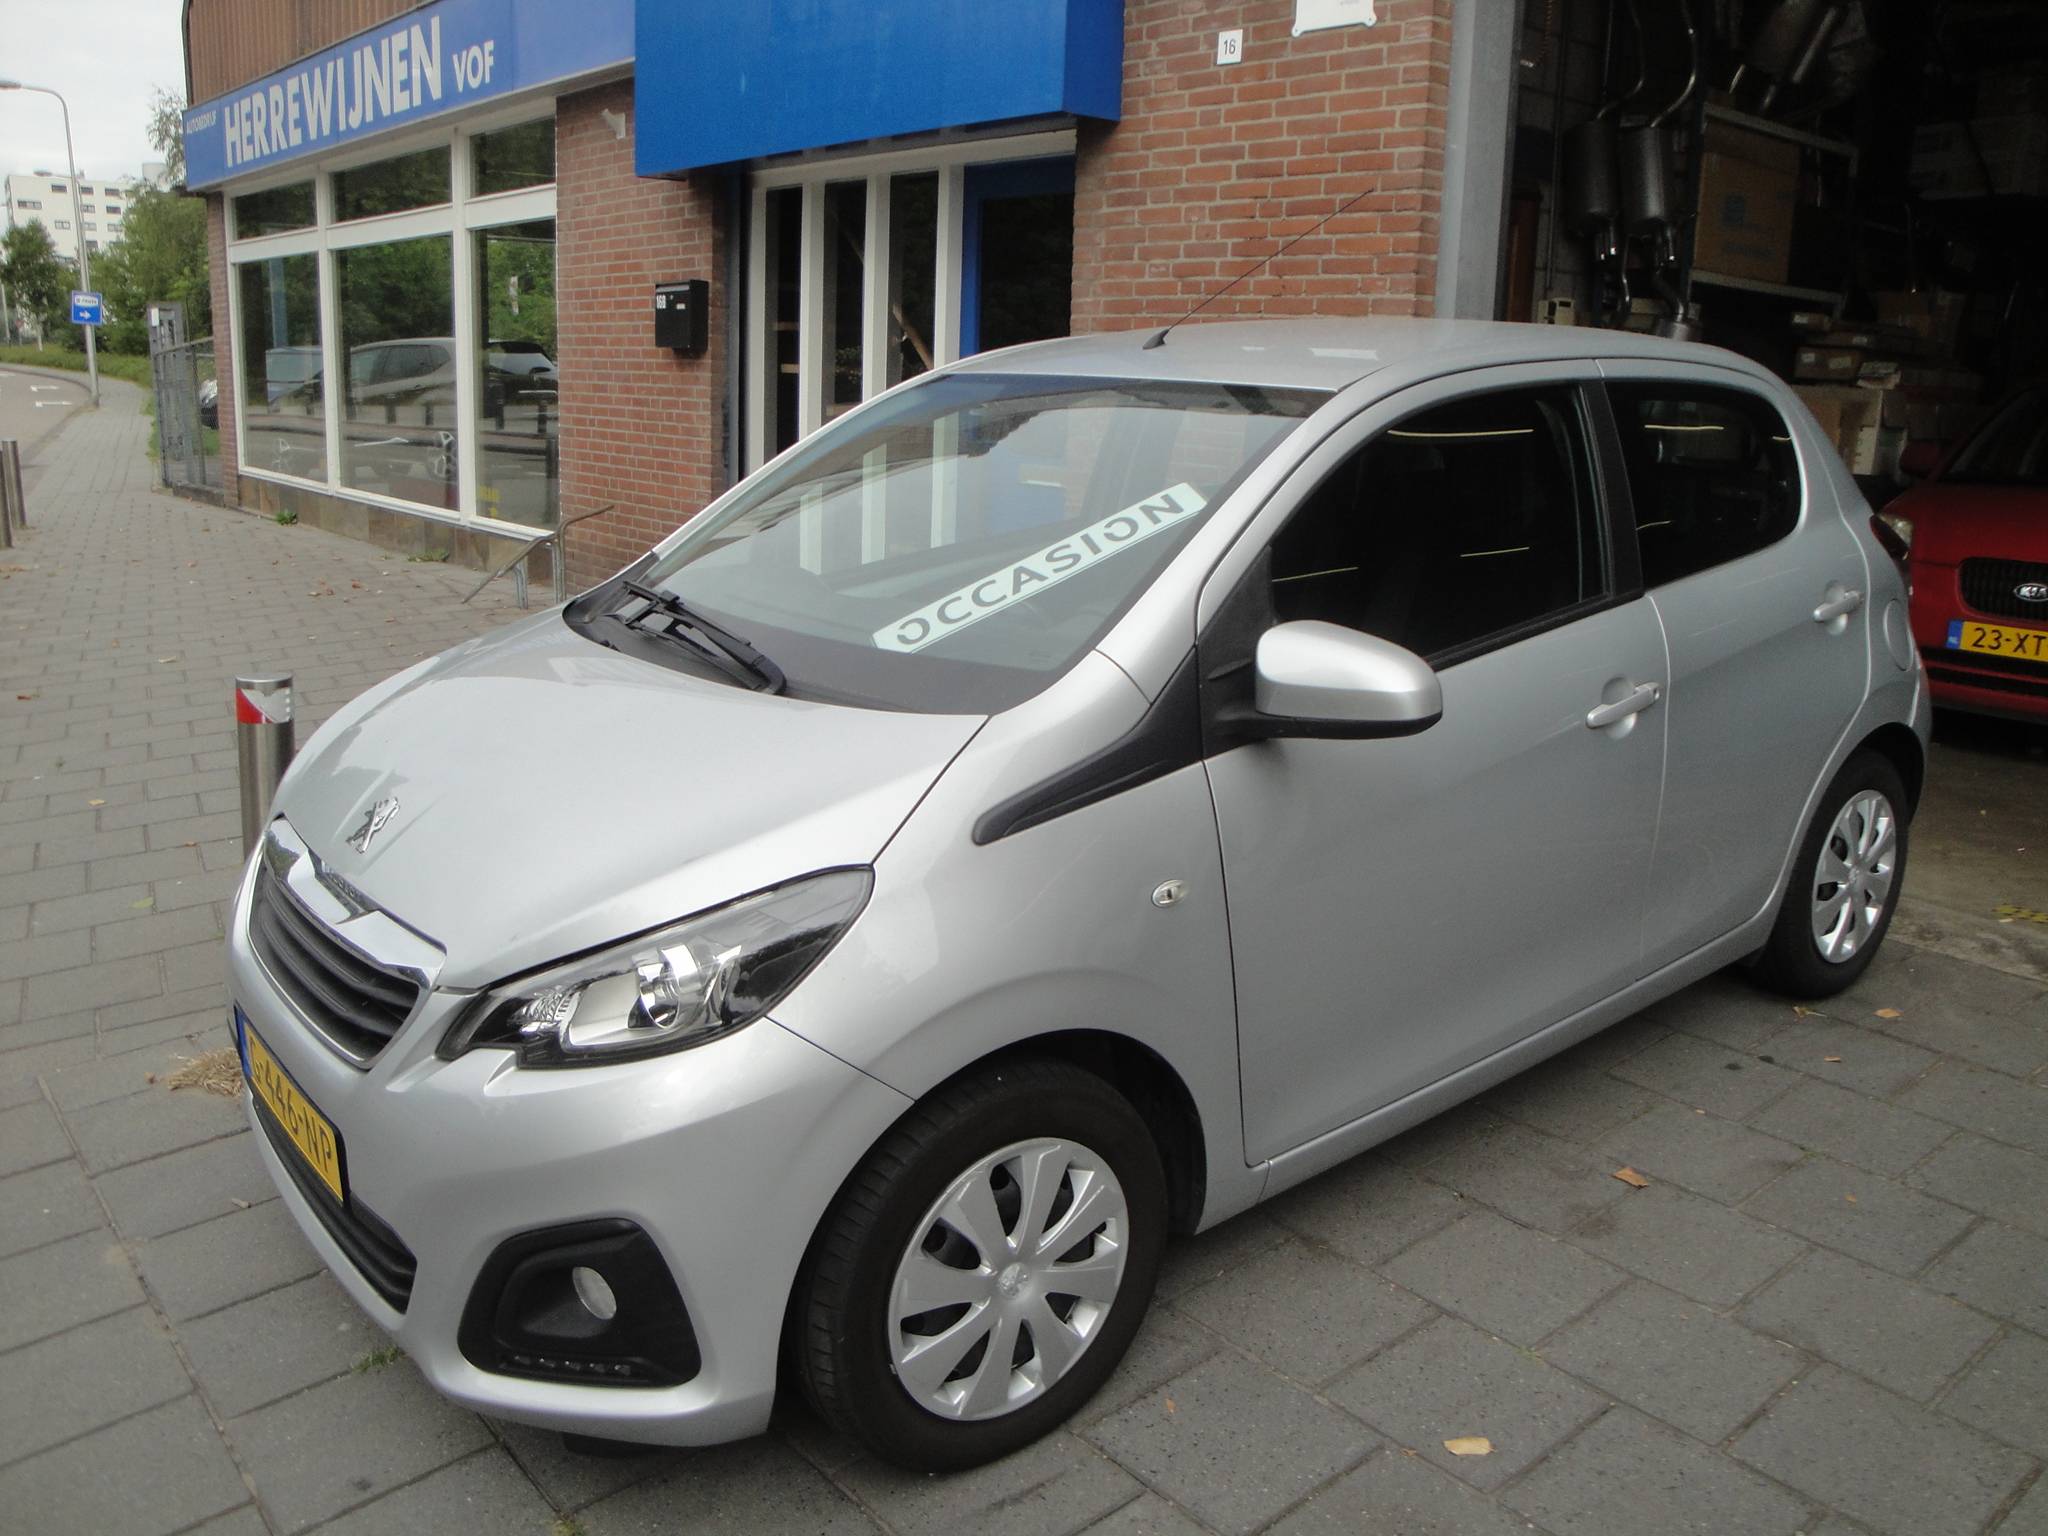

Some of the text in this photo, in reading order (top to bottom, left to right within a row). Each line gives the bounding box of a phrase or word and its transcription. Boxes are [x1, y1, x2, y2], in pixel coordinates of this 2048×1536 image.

[225, 16, 494, 168] HERREWIJNEN VOF
[1223, 38, 1236, 55] 16
[897, 494, 1185, 646] OCCASION
